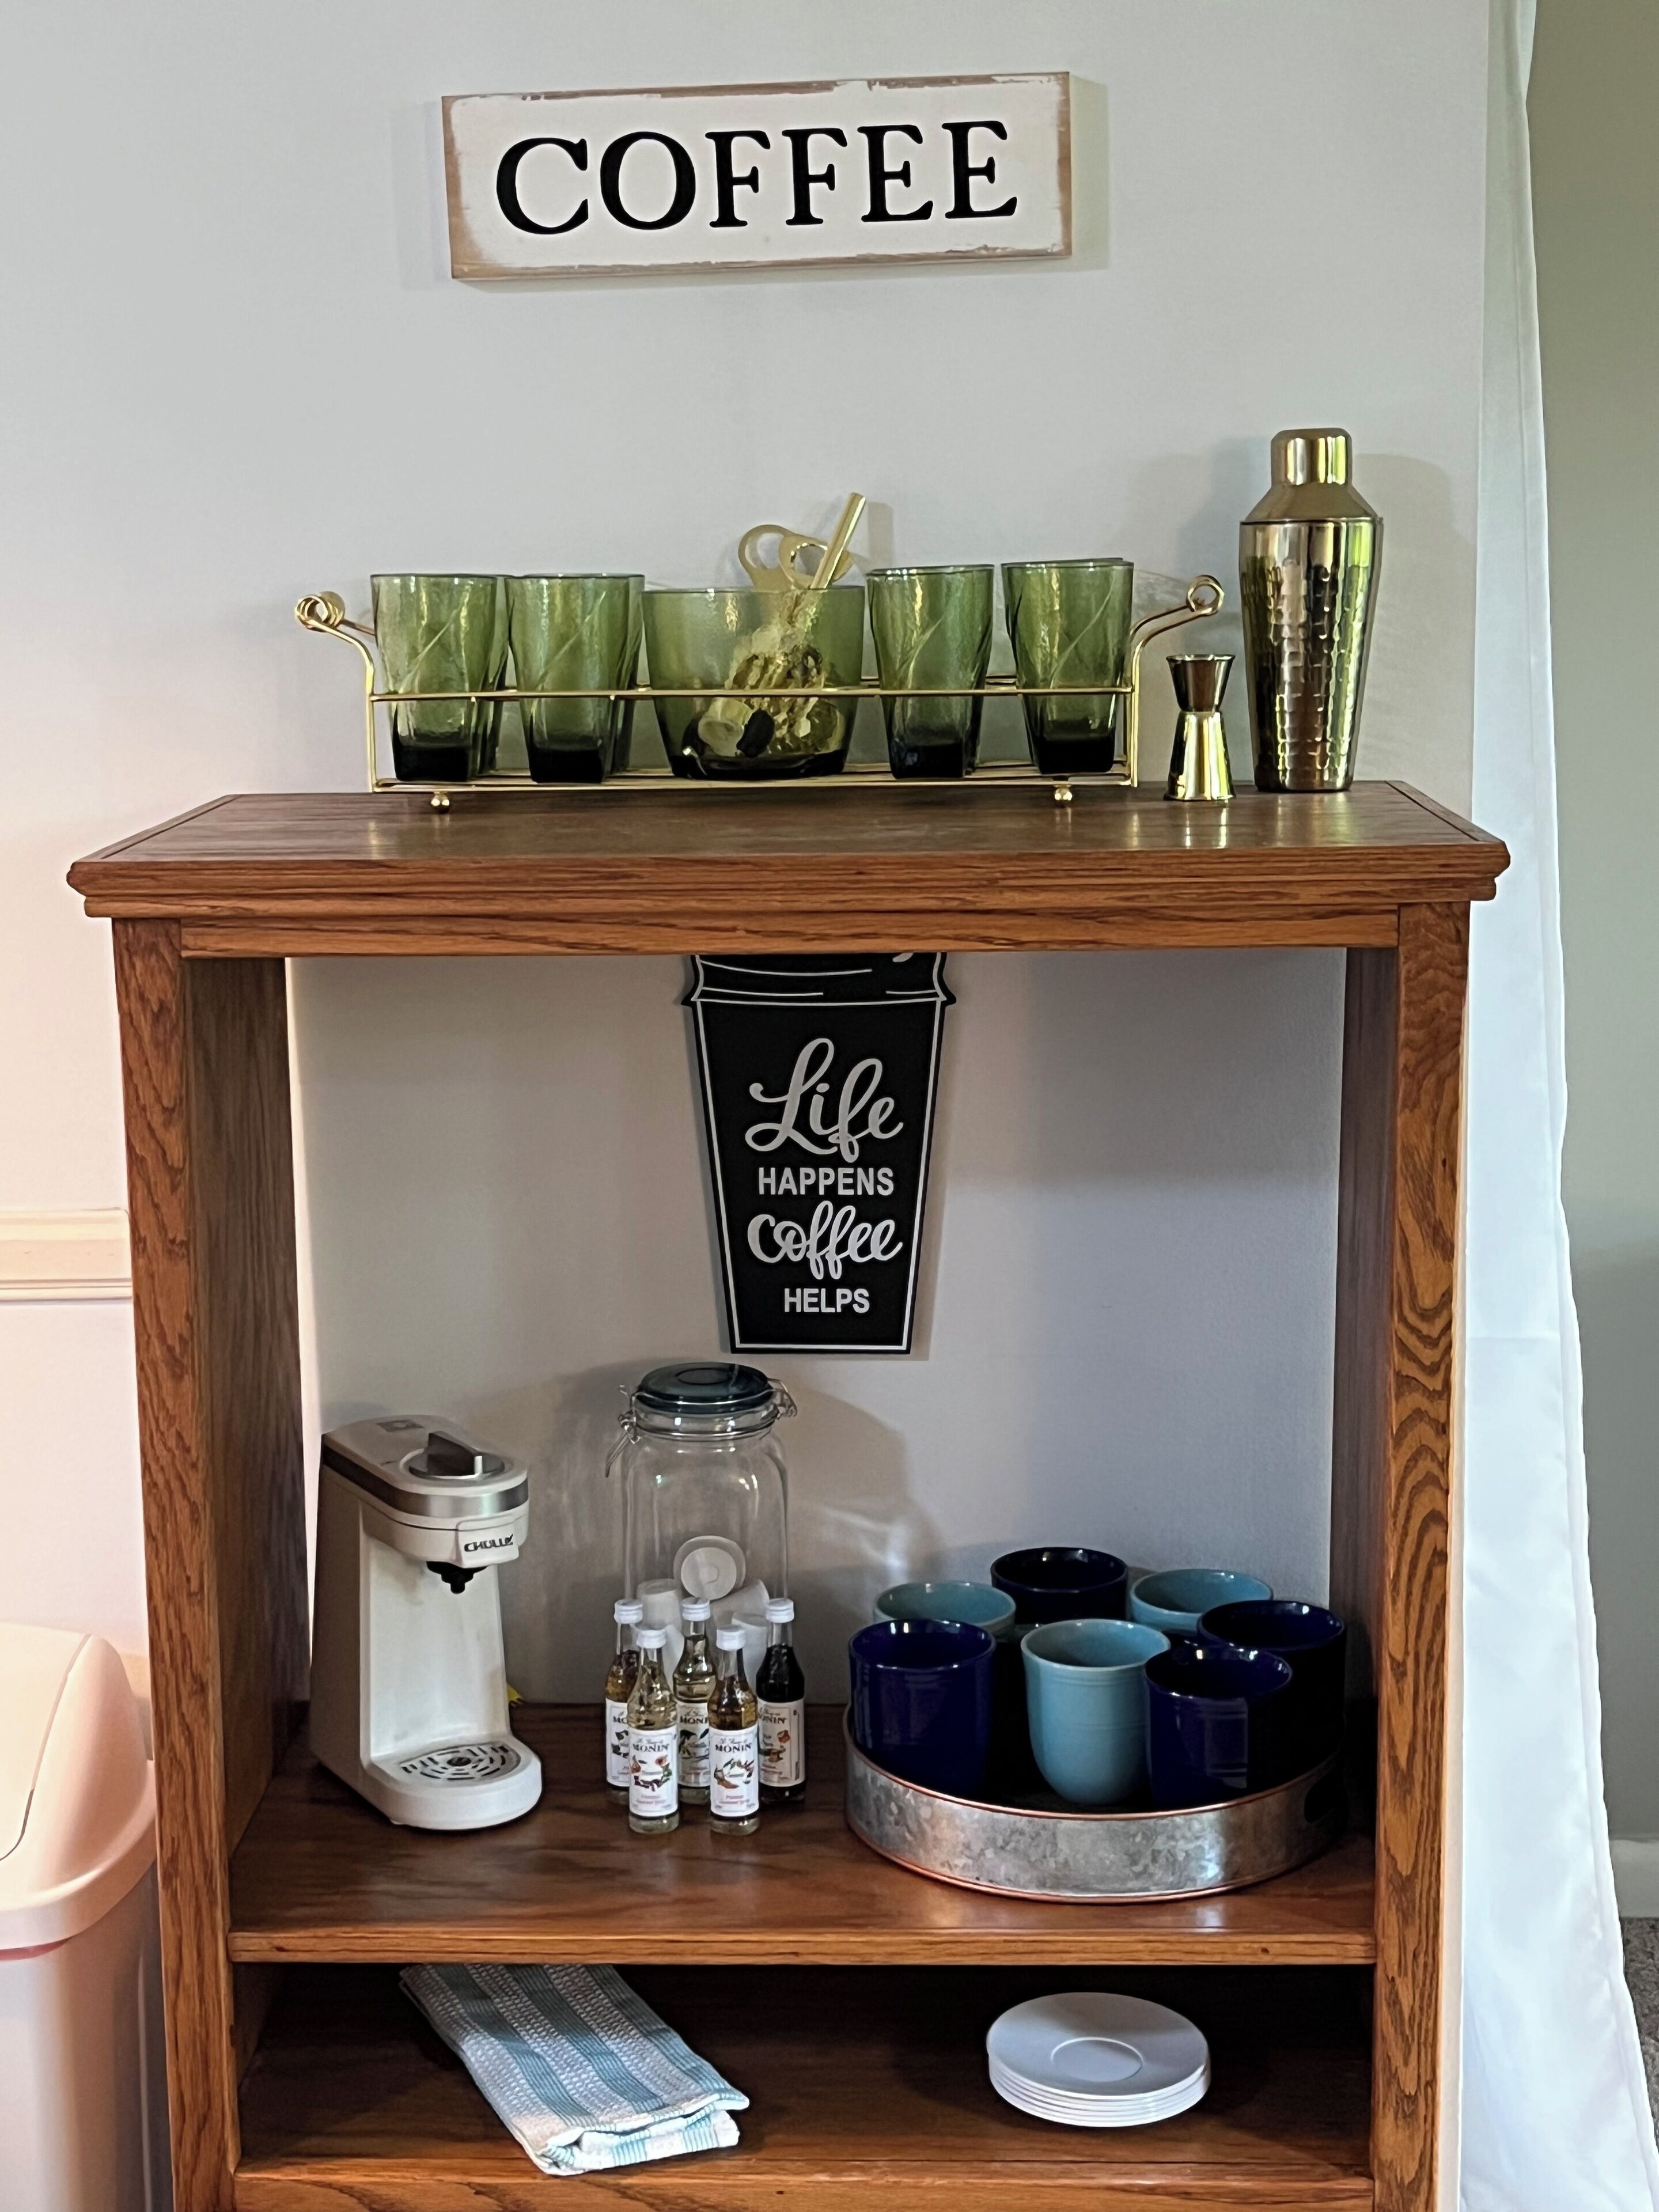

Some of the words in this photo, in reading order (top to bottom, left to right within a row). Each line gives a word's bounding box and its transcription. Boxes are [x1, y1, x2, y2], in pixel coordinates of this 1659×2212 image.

[496, 120, 1018, 235] COFFEE
[745, 1037, 904, 1163] Life
[758, 1167, 894, 1196] HAPPENS
[784, 1287, 870, 1313] HELPS
[679, 1715, 709, 1724] MONI
[632, 1743, 669, 1752] MONIN
[715, 1742, 752, 1753] MONIN
